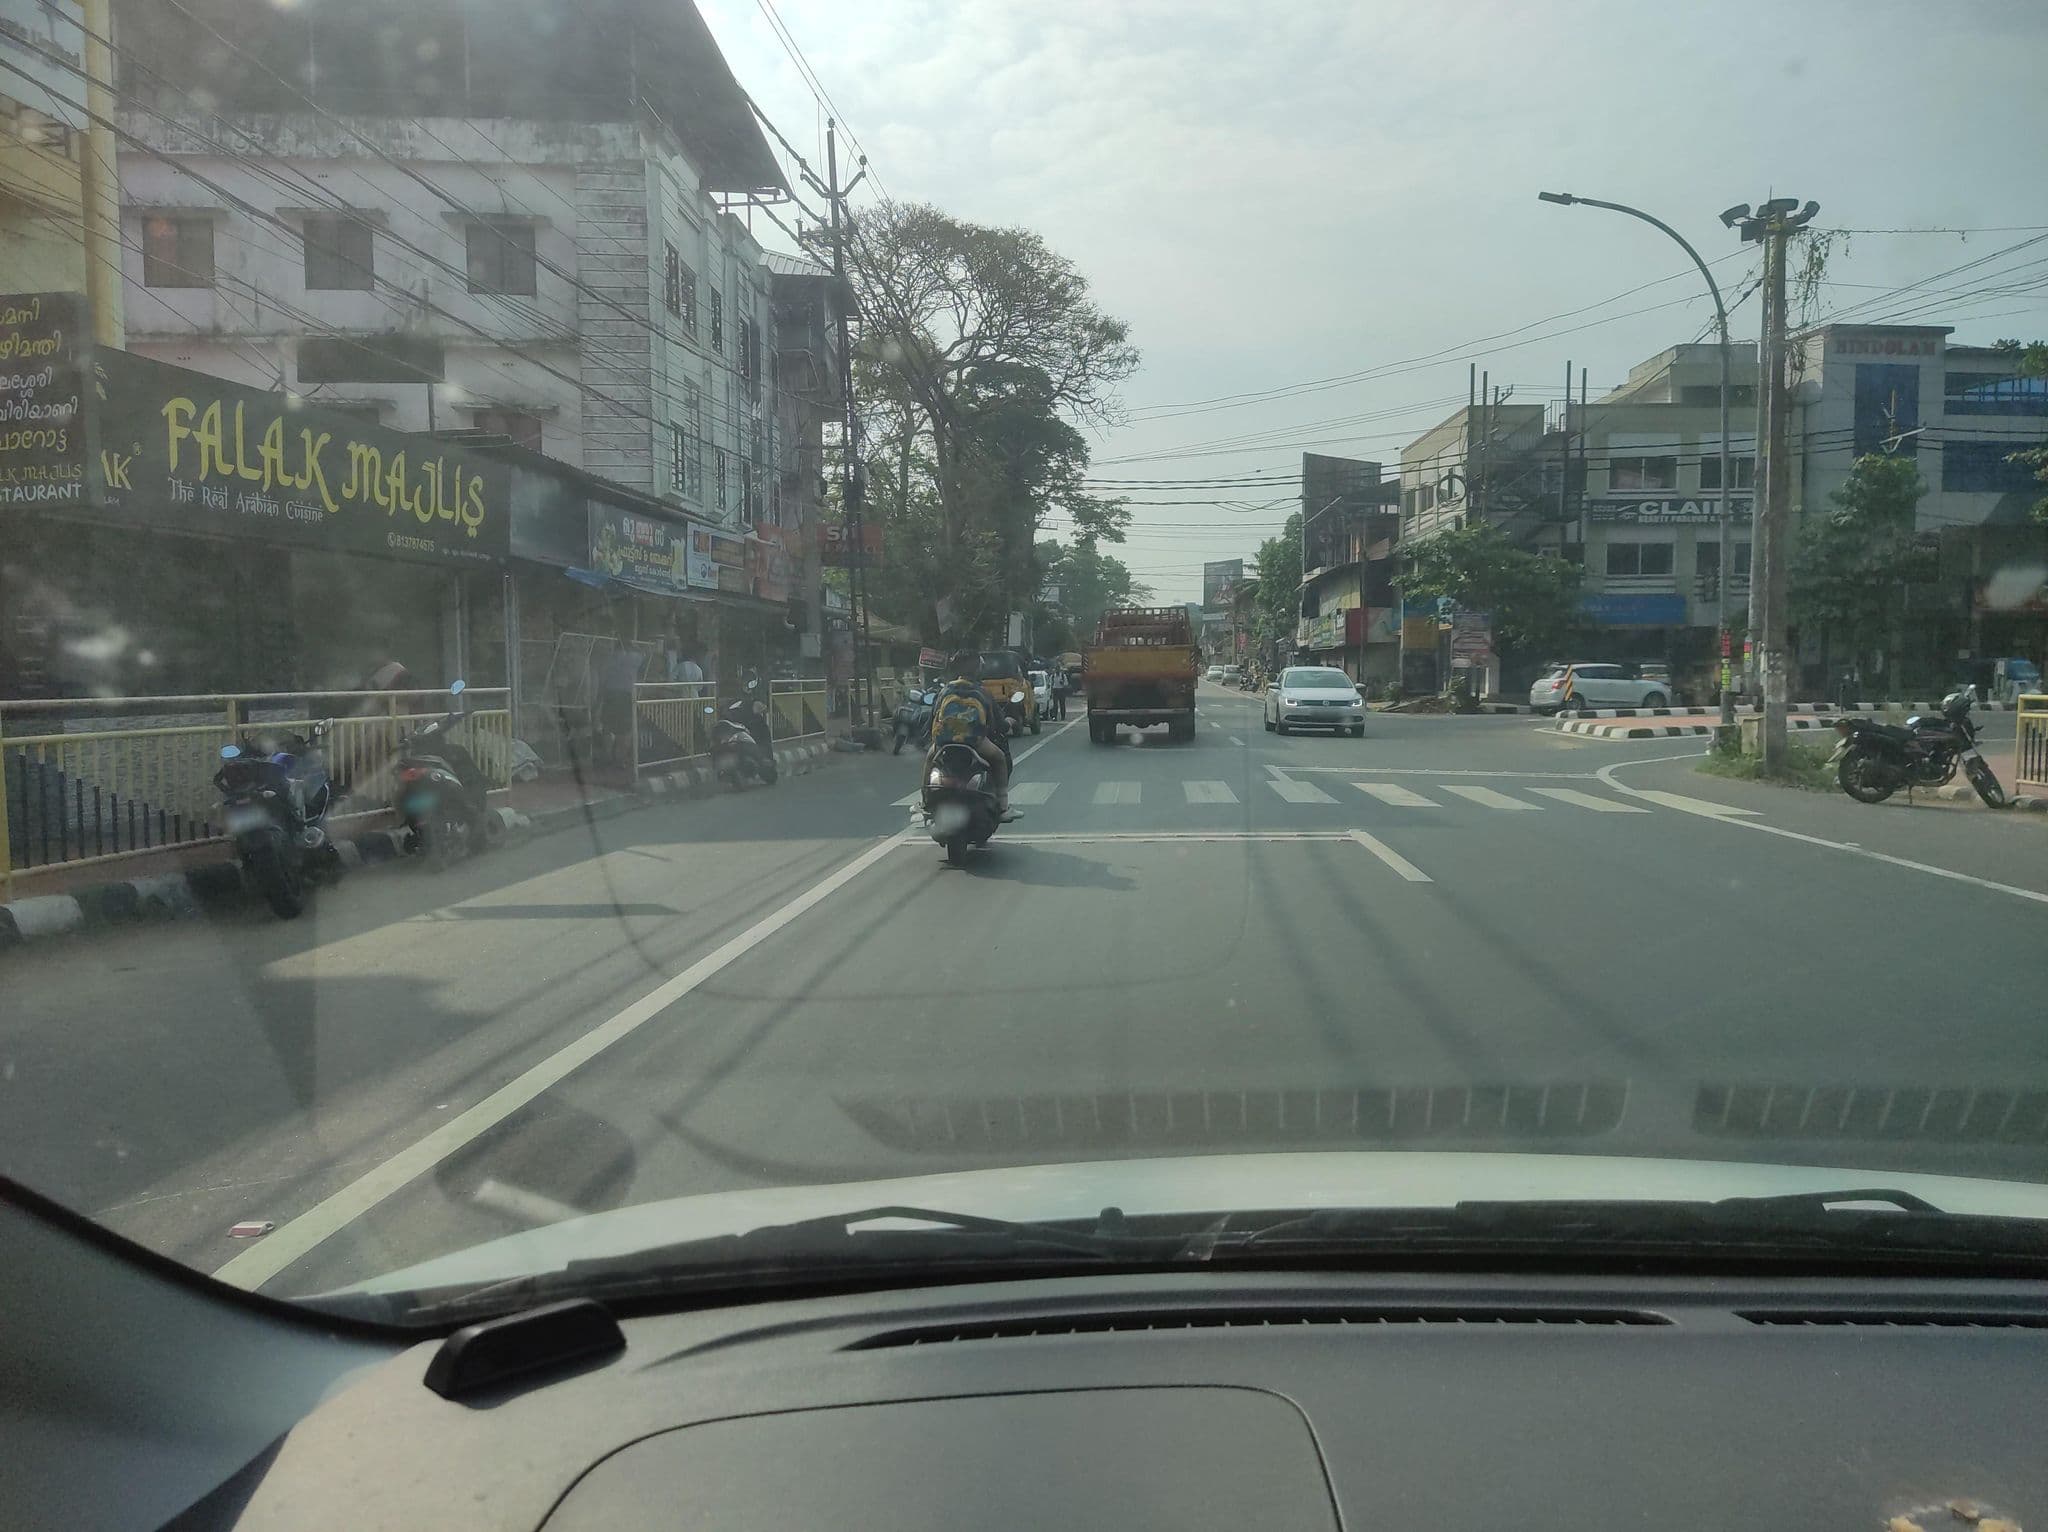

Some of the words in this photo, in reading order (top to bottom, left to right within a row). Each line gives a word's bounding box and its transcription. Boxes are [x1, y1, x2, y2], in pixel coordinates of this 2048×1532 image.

[161, 397, 339, 513] FALAK
[342, 440, 485, 538] MAJLIS
[0, 482, 82, 502] TAURANT
[168, 477, 195, 502] The
[202, 486, 229, 510] Real
[236, 491, 280, 517] Arabian
[286, 500, 325, 525] Cuisine
